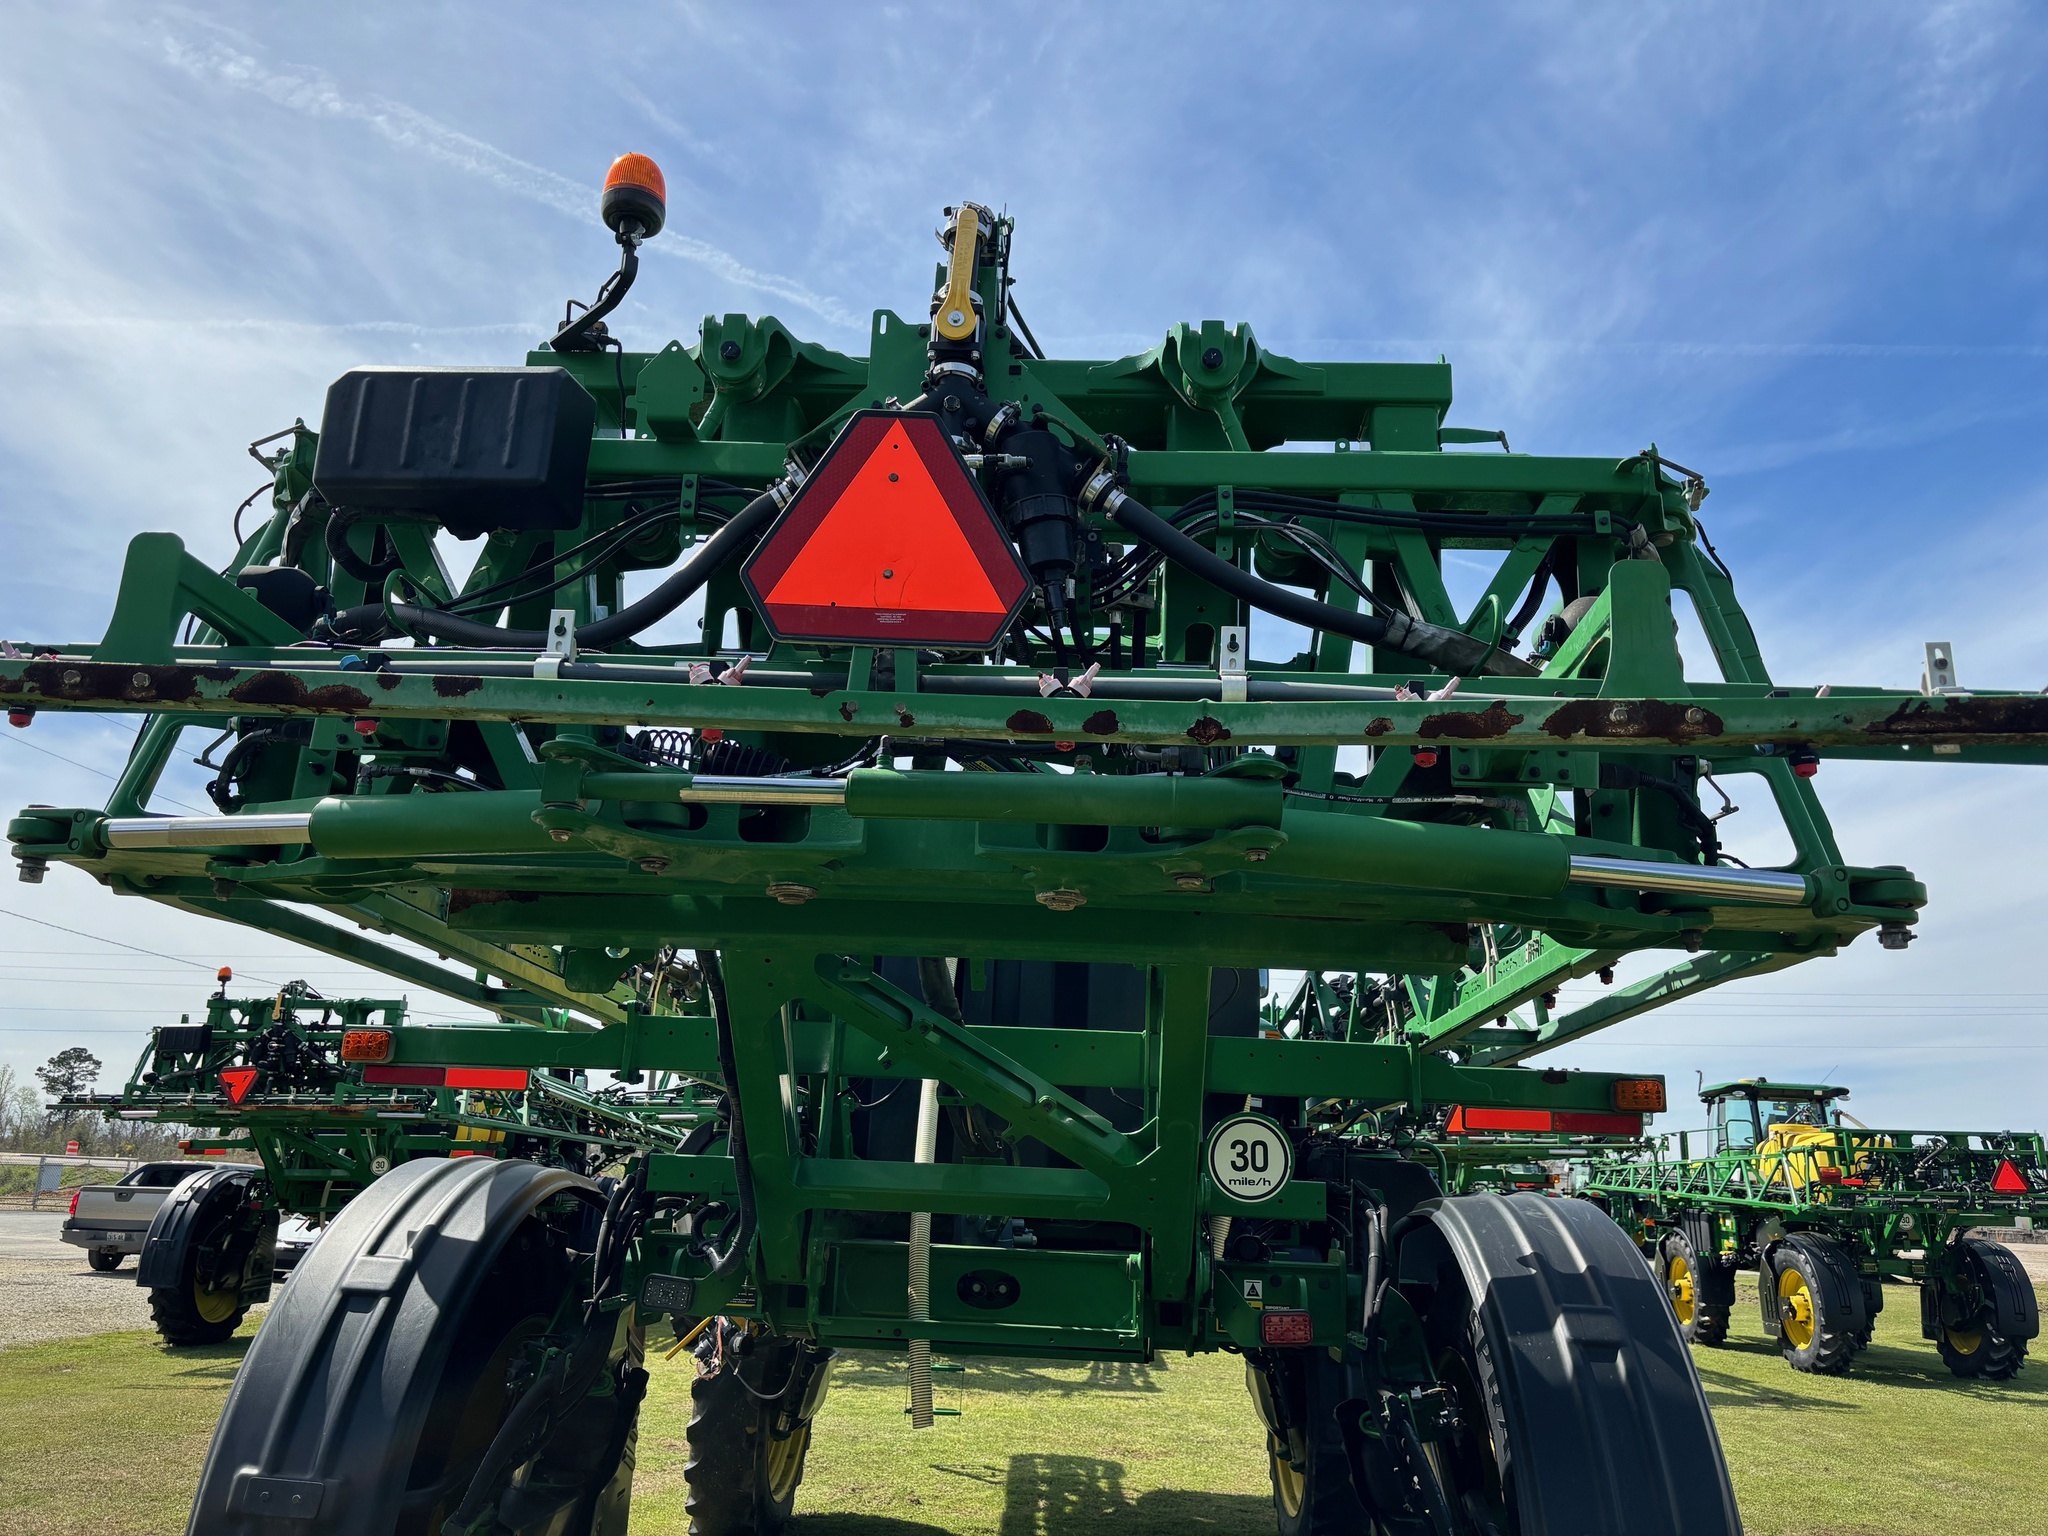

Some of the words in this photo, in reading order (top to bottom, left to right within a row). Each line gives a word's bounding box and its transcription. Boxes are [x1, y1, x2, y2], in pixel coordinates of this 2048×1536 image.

[1230, 1139, 1269, 1172] 30
[375, 1160, 385, 1169] 30
[1228, 1177, 1272, 1187] mile/h
